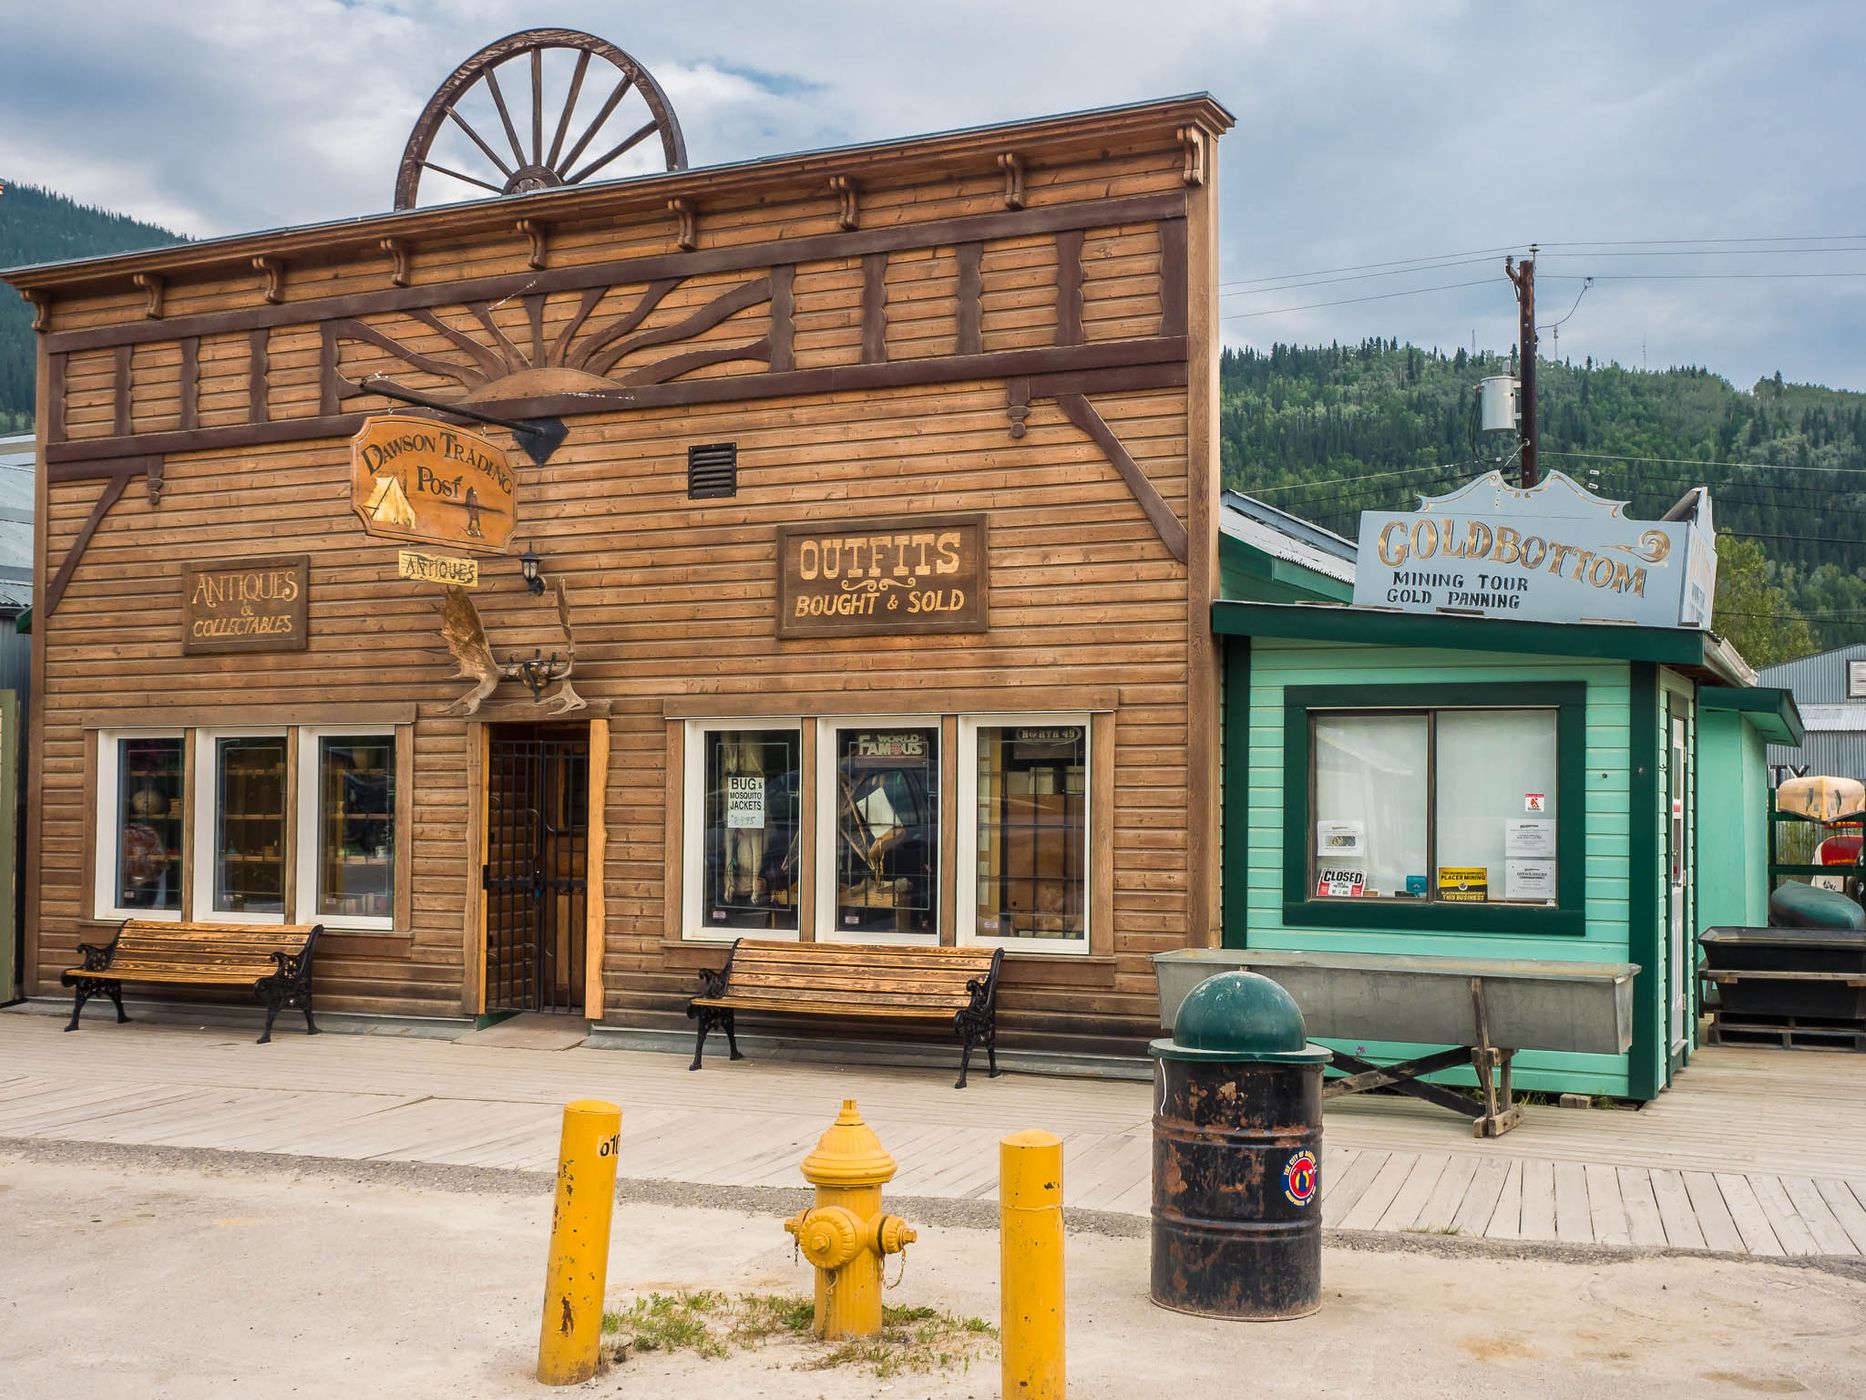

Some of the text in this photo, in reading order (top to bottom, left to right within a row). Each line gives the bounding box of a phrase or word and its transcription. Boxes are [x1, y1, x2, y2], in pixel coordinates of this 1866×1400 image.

[360, 432, 513, 495] DAWSON TRADING
[800, 532, 961, 580] OUTFITS
[1378, 518, 1648, 599] GOLDBOTTOM
[405, 557, 476, 584] ANTIQUES
[1393, 571, 1528, 591] MINING TOUR
[192, 571, 298, 608] ANTIQUES
[1387, 588, 1520, 609] GOLD PANNING
[241, 600, 254, 616] &
[795, 589, 965, 617] BOUGHT & SOLD
[193, 615, 293, 637] COLLECTABLES
[859, 734, 923, 756] FAMOUS
[877, 734, 920, 743] WORLD
[731, 778, 757, 790] BUG
[730, 792, 762, 800] MOSQUITO
[730, 801, 762, 810] JACKETS
[1324, 870, 1362, 884] CLOSED
